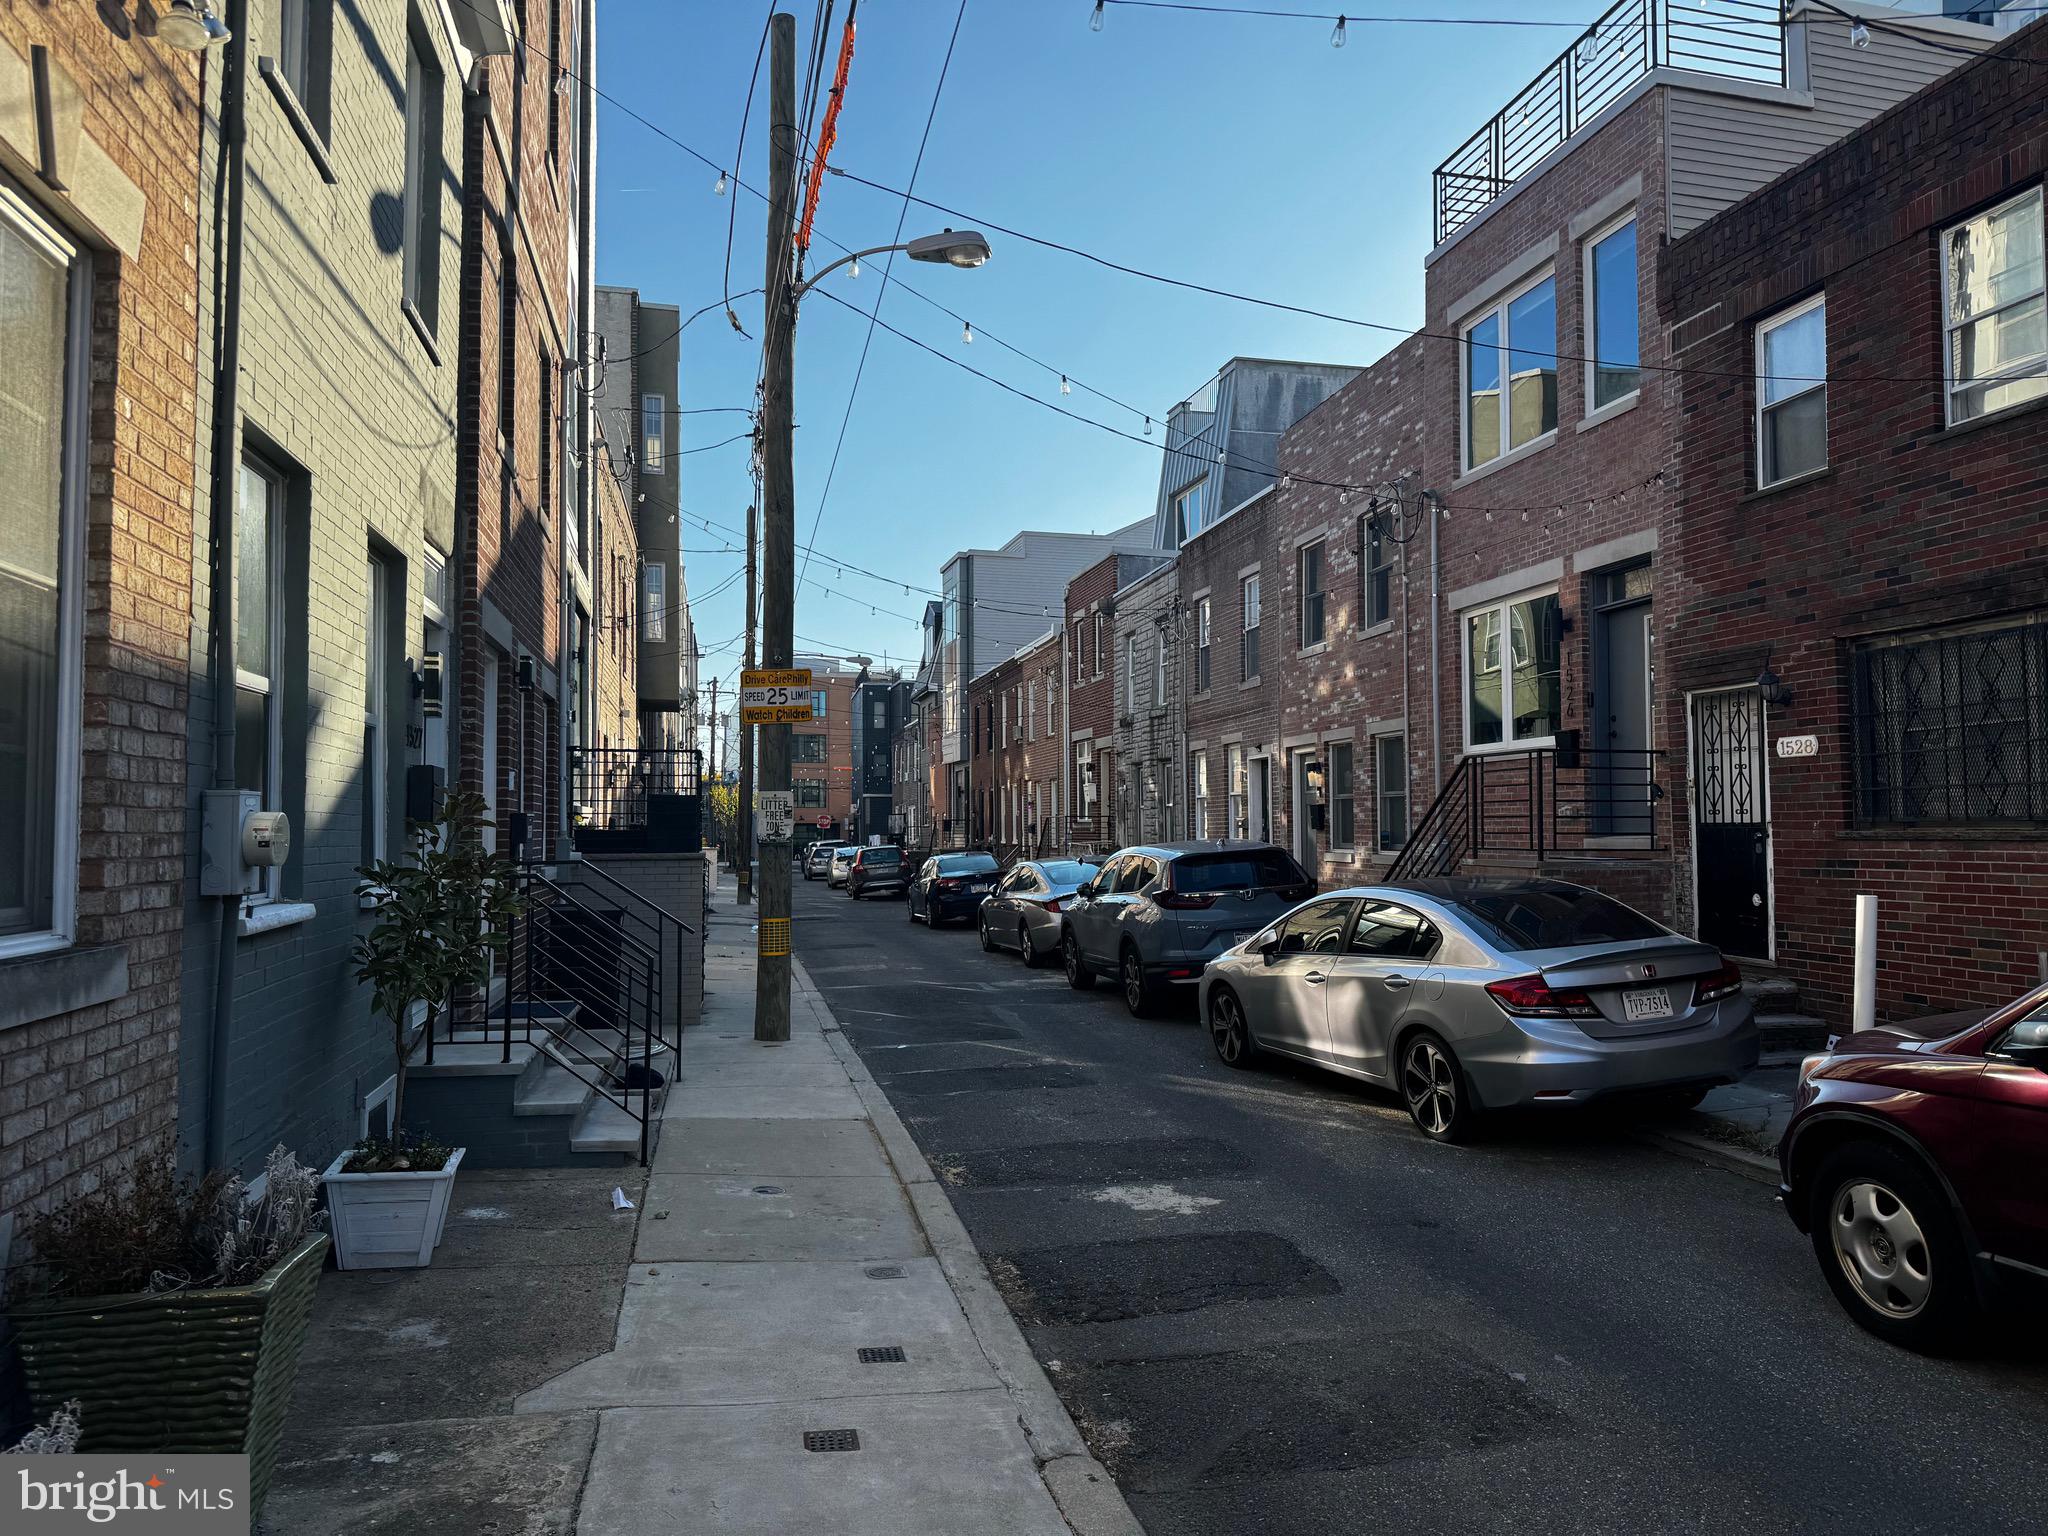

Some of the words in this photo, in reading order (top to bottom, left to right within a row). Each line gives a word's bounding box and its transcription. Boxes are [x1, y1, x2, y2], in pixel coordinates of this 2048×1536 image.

[745, 675, 765, 685] Drive
[1566, 651, 1575, 718] 1526
[744, 692, 765, 702] SPEED
[766, 687, 788, 705] 25
[790, 690, 809, 701] LIMIT
[745, 710, 773, 721] Watch
[776, 709, 810, 721] Children
[1780, 738, 1814, 756] 1528
[761, 799, 788, 811] LITTER
[765, 810, 784, 821] FREE
[766, 821, 785, 832] ZONE
